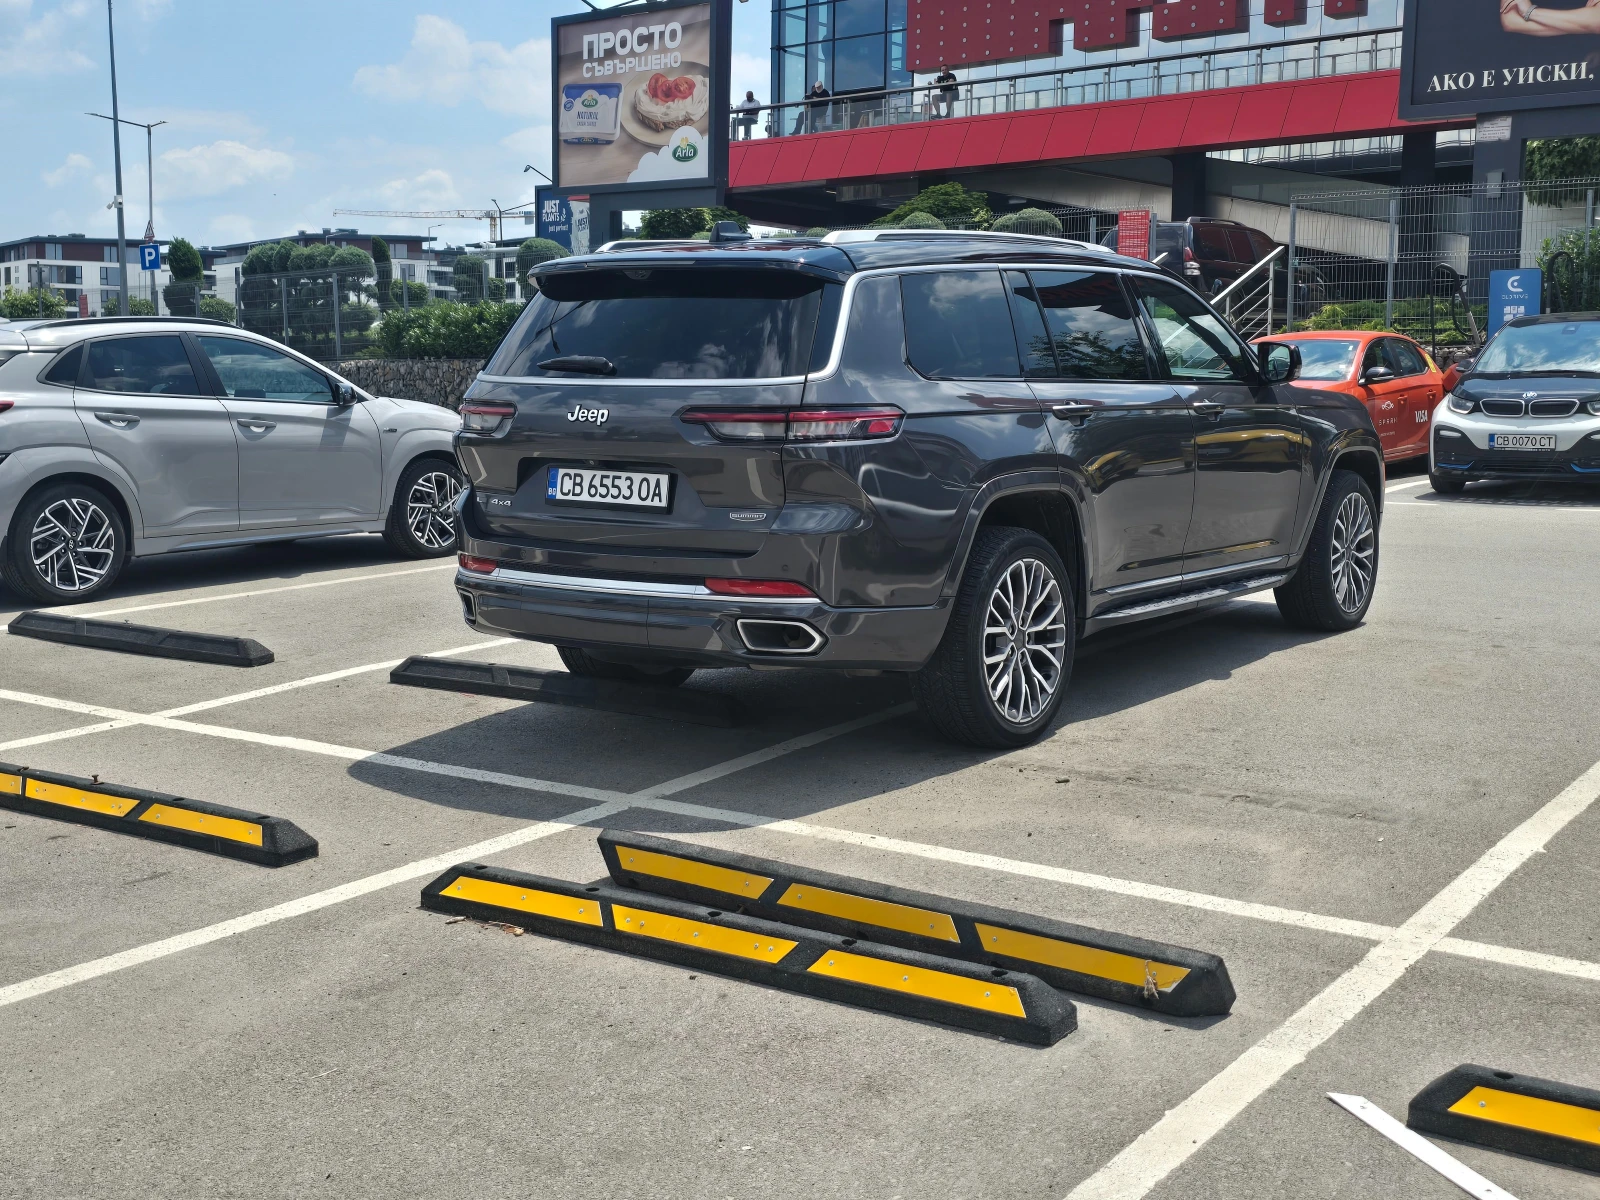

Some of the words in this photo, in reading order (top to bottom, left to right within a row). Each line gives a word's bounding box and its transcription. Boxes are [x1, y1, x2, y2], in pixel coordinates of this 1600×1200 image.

[583, 22, 682, 60] ПРОСТО
[583, 51, 681, 78] СЪВЪРШЕНО
[1427, 72, 1475, 92] АКО
[1502, 61, 1595, 86] УИСКИ,
[675, 146, 694, 158] Arla
[543, 200, 559, 213] JUST
[543, 212, 560, 222] PLANTS
[145, 248, 156, 267] P
[567, 404, 609, 426] Jeep
[1415, 409, 1428, 423] VISA
[1496, 436, 1509, 446] CB
[1512, 436, 1537, 447] 0070
[1540, 436, 1553, 447] CT
[560, 472, 584, 497] CB
[587, 474, 634, 501] 6553
[491, 498, 512, 507] 4x4
